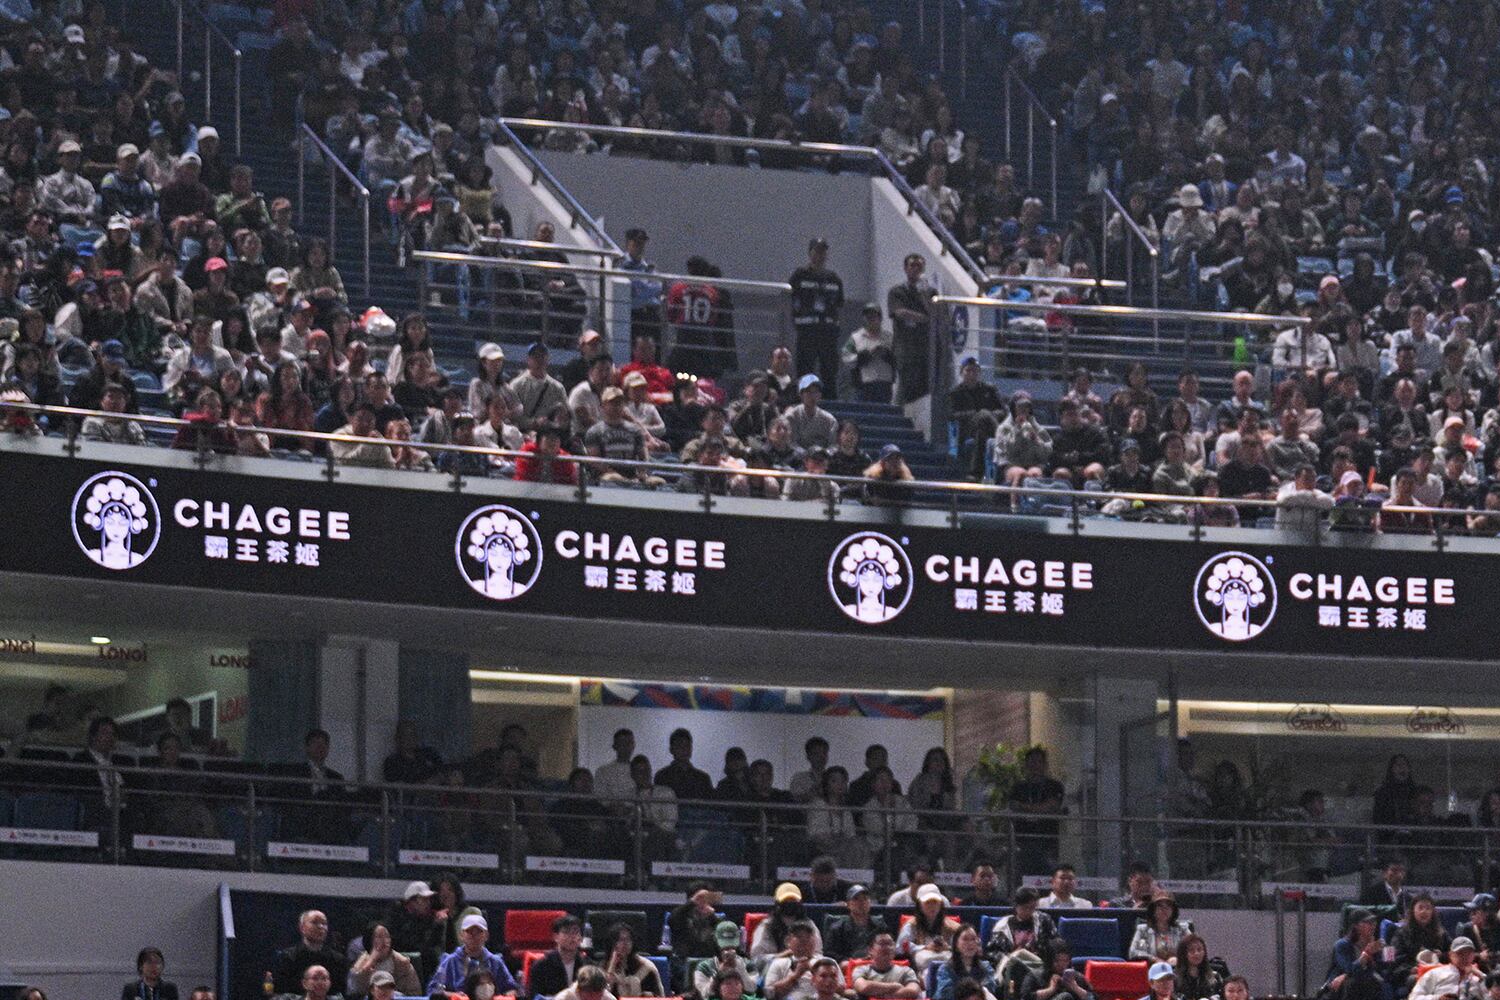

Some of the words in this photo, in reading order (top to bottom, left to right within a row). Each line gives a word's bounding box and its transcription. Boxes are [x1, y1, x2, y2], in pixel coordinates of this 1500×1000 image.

[683, 294, 711, 323] 10
[174, 499, 350, 540] CHAGEE
[554, 530, 726, 569] CHAGEE
[924, 554, 1094, 589] CHAGEE
[1289, 573, 1456, 605] CHAGEE
